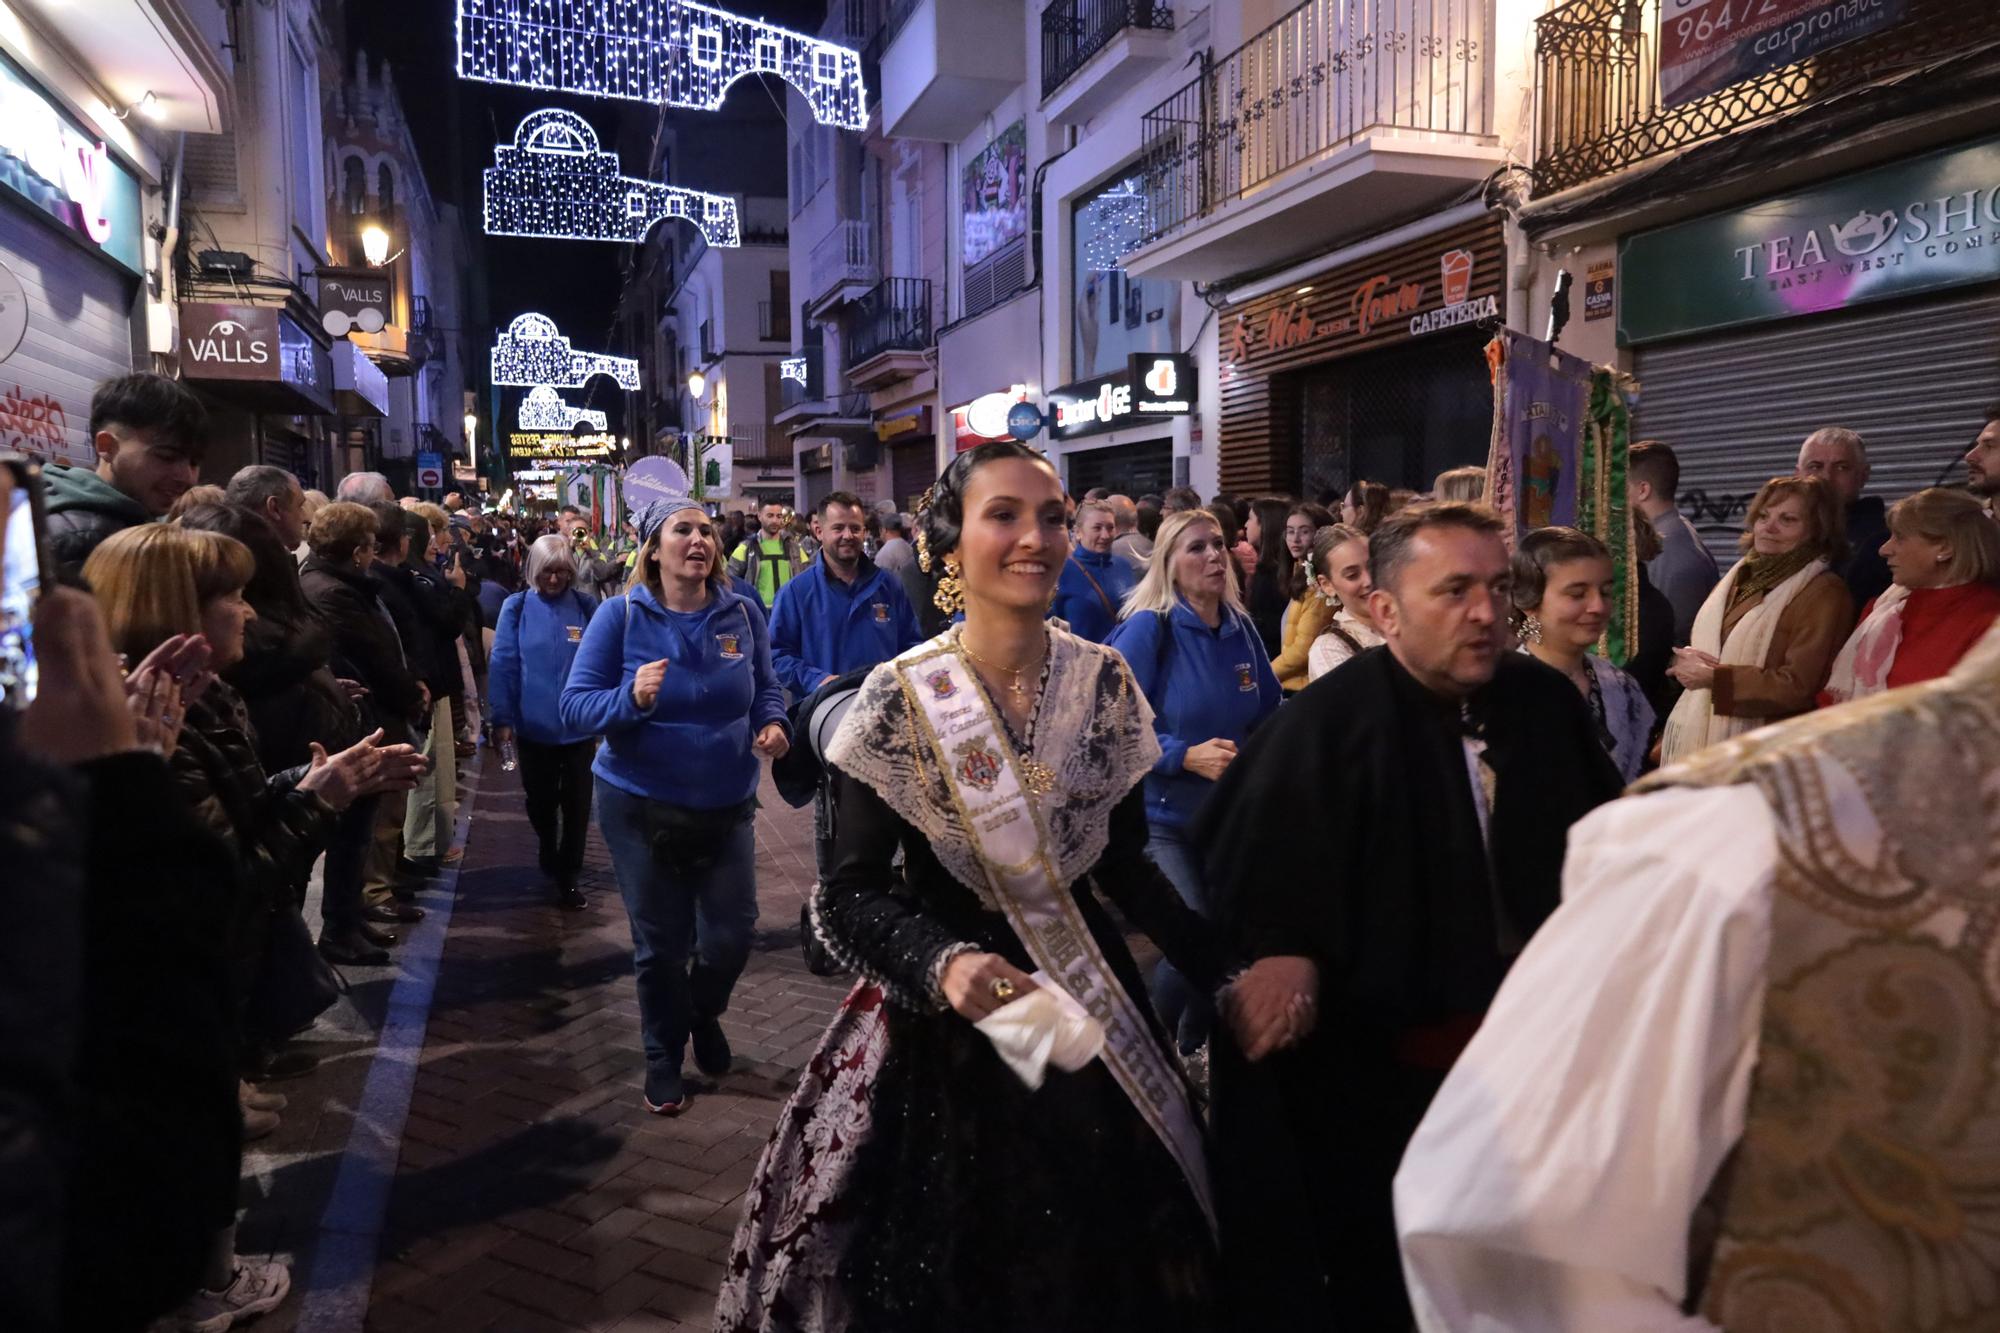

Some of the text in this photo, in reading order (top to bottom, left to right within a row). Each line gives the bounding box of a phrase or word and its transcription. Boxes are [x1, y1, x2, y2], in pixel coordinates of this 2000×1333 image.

[1677, 0, 1733, 48] 964
[1734, 230, 1829, 280] TEA
[1839, 252, 1904, 277] WEST
[340, 288, 383, 303] VALLS
[1264, 274, 1426, 351] Wok SUSHI Town
[1409, 294, 1499, 336] CAFETERIA
[187, 337, 269, 364] VALLS
[1037, 918, 1168, 1113] Madrina
